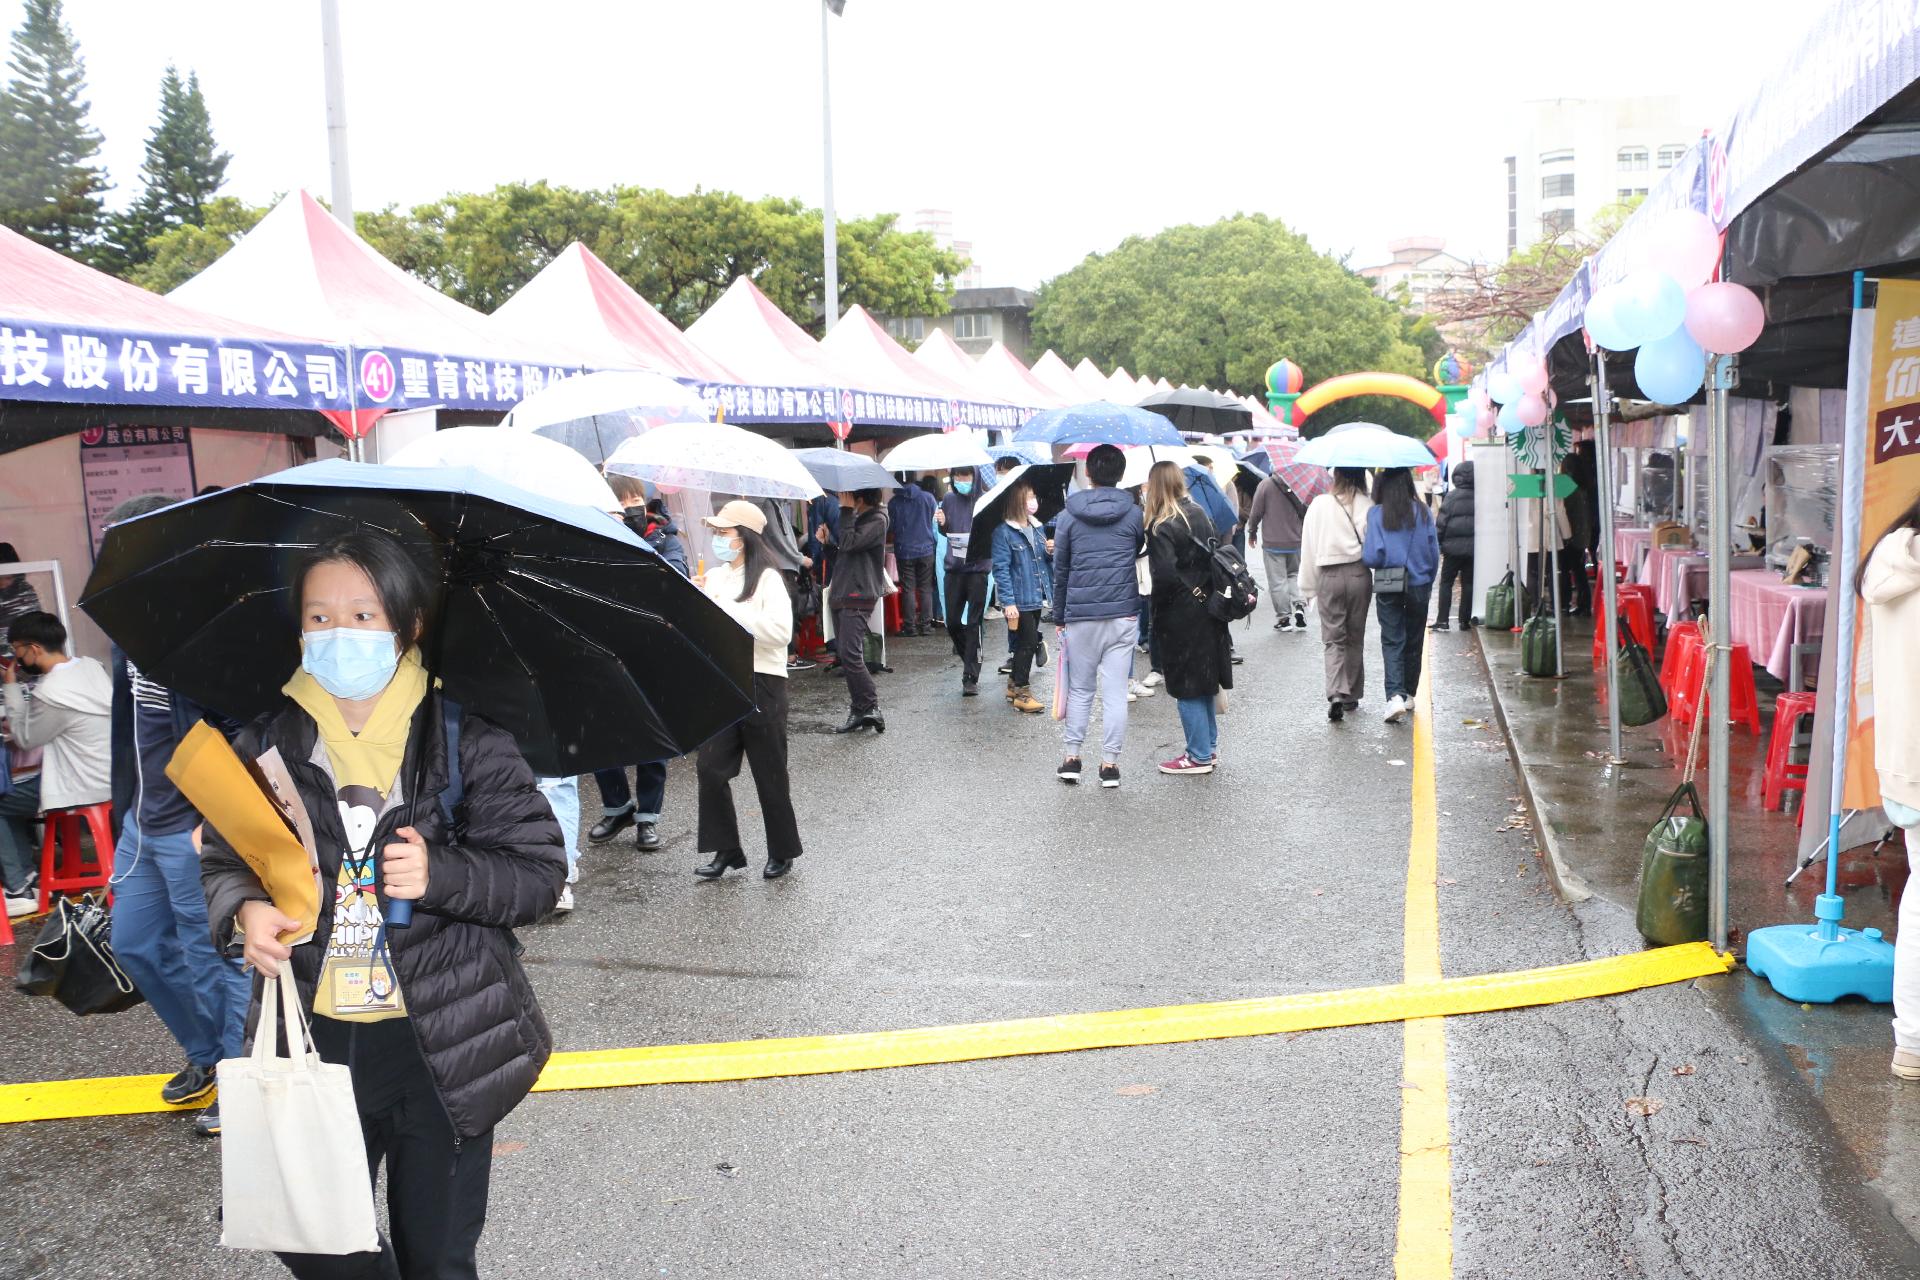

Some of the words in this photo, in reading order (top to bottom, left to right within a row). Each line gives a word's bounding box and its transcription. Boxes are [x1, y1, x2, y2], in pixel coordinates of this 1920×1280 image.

[0, 327, 339, 400] 技股份有限公司
[366, 362, 389, 392] 41
[1882, 415, 1920, 453] 大
